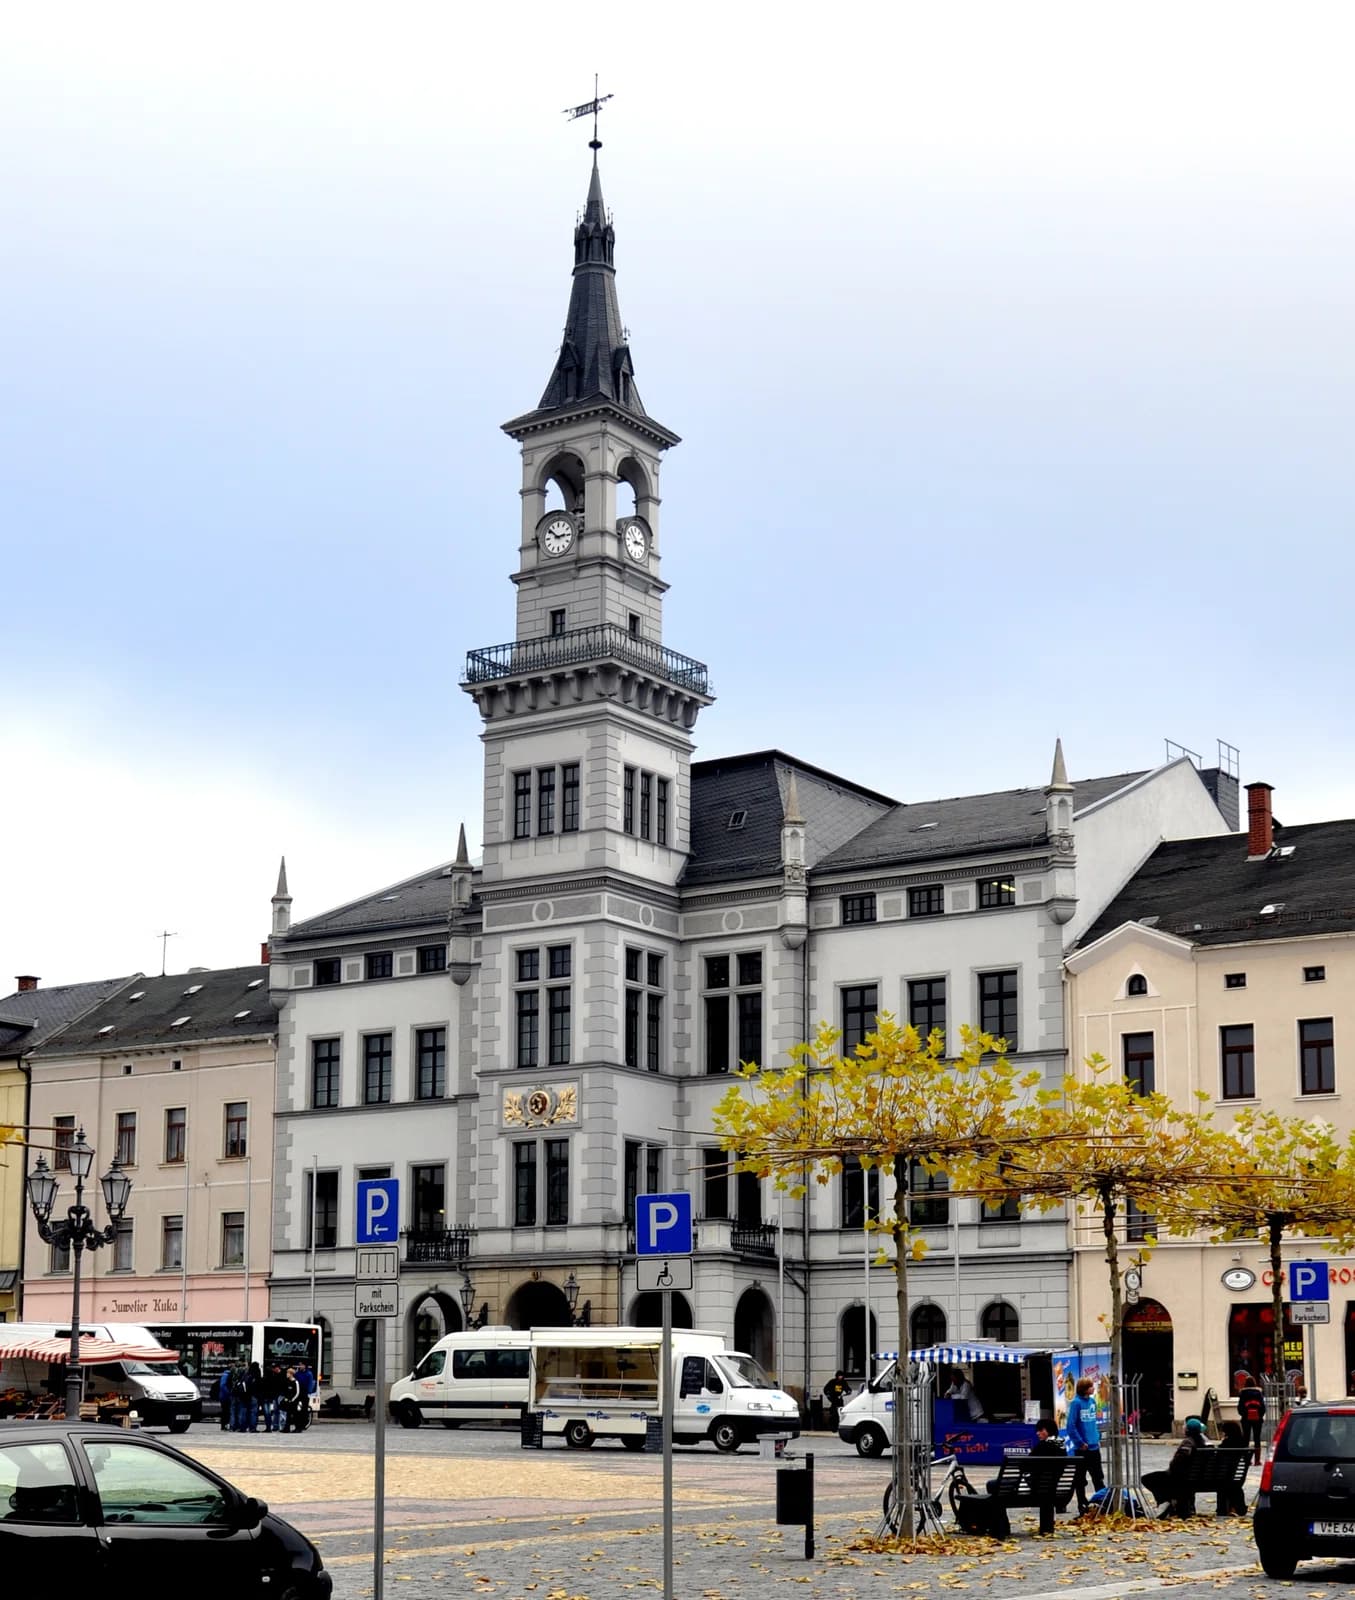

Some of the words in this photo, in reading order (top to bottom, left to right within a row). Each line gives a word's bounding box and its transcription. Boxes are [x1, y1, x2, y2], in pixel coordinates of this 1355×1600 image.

[366, 1187, 389, 1236] P
[649, 1202, 679, 1247] P
[1296, 1267, 1317, 1296] P
[371, 1288, 382, 1299] mit
[112, 1298, 148, 1313] Juwelier
[152, 1298, 178, 1312] Kuka
[359, 1302, 394, 1313] Parkschein
[274, 1337, 309, 1353] Oppel
